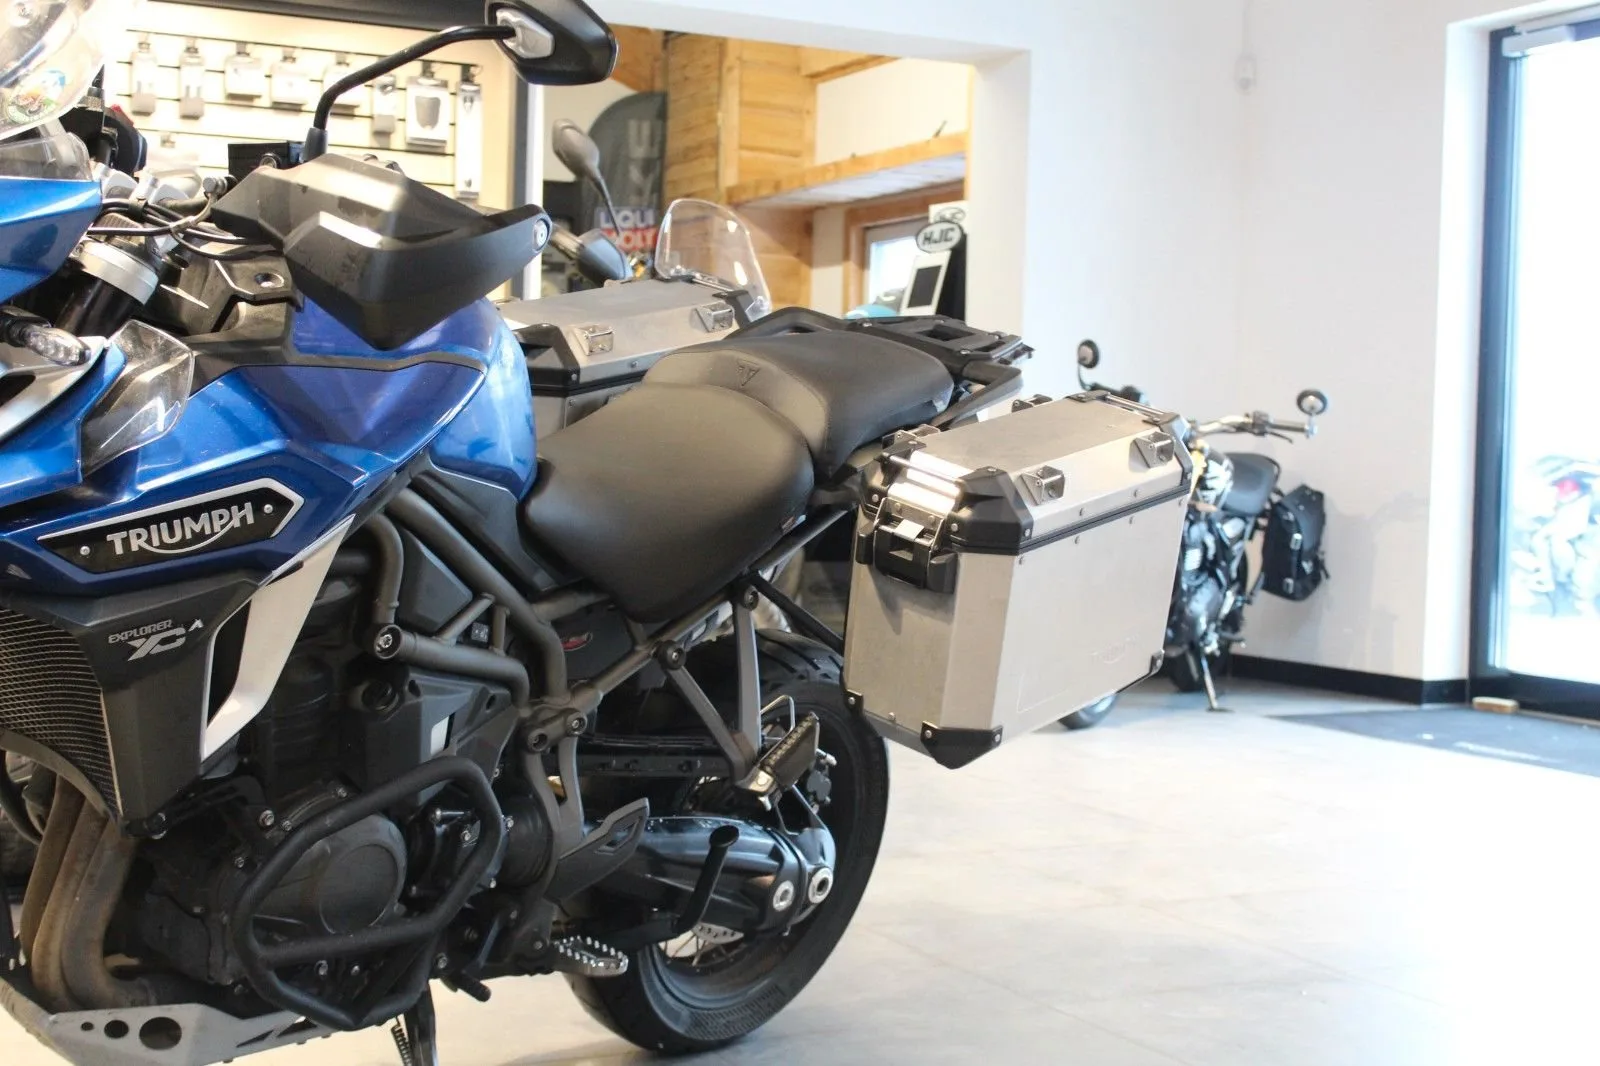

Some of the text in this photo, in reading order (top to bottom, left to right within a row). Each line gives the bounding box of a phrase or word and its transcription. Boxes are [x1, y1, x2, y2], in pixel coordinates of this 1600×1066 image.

[922, 227, 955, 246] HJC
[106, 502, 255, 555] TRIUMPH
[107, 619, 173, 644] EXPLORER
